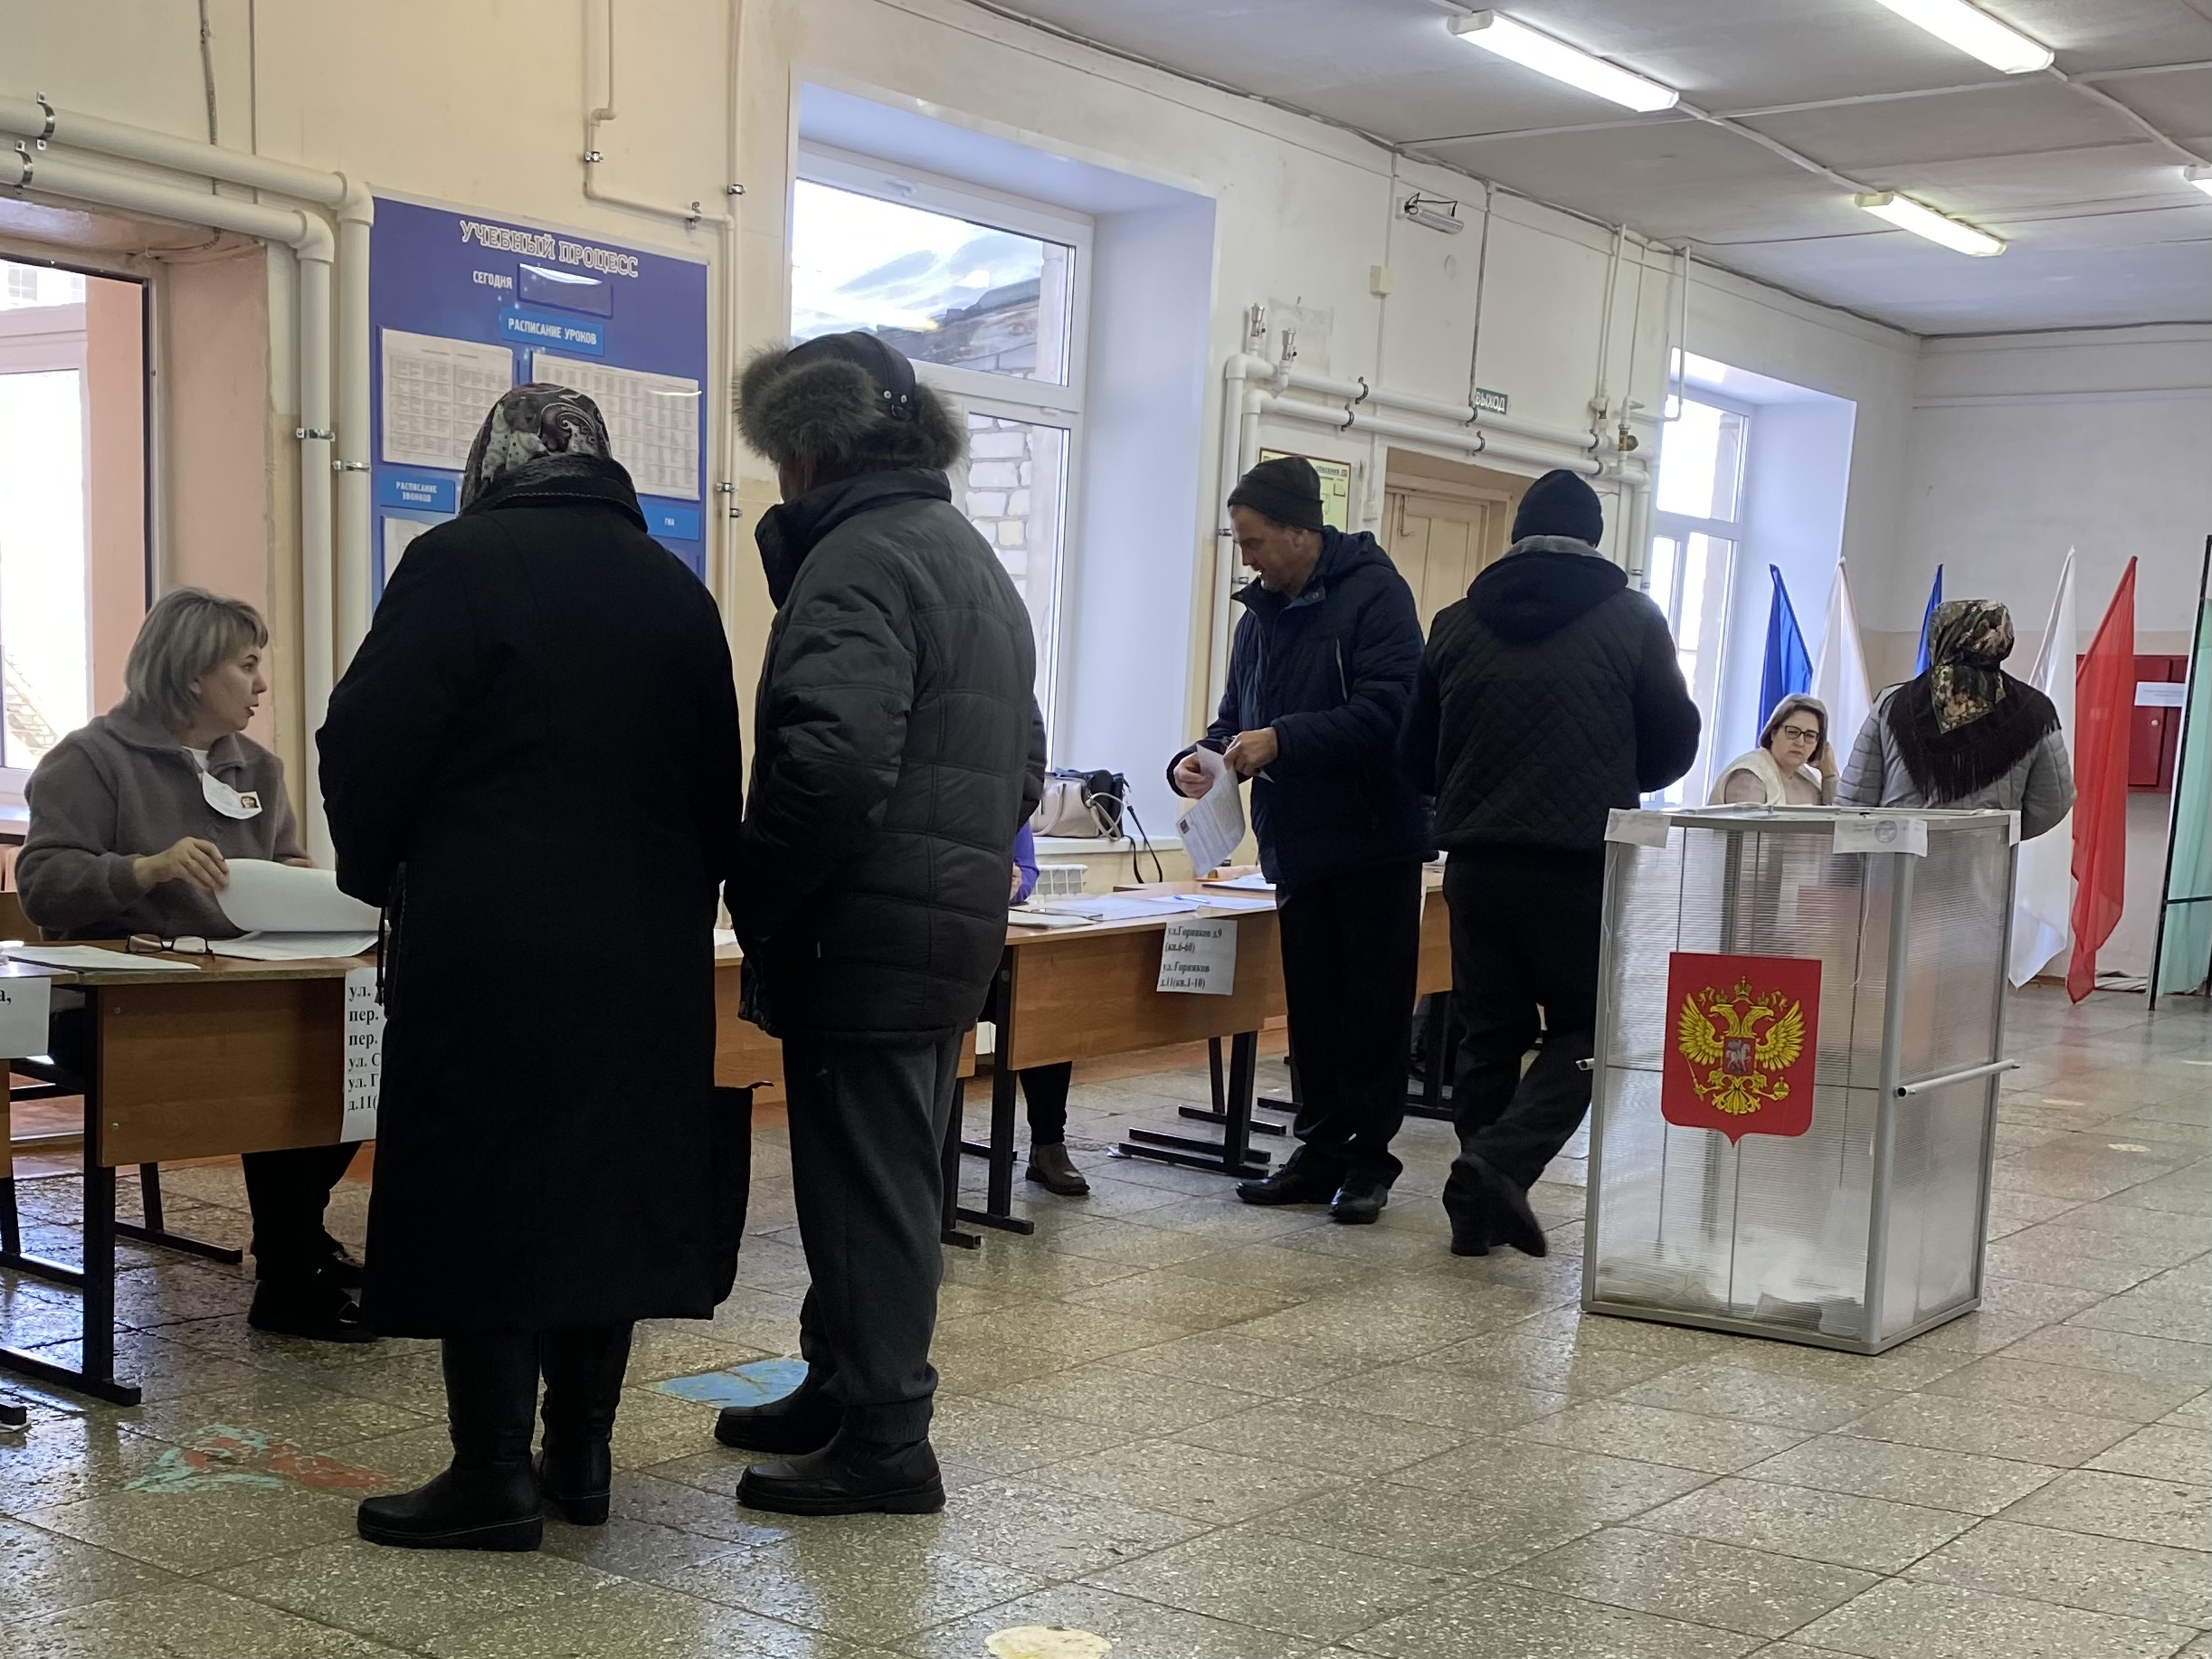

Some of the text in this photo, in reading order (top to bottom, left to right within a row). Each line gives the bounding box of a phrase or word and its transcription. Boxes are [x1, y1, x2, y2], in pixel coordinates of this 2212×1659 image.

[460, 220, 639, 278] УЧЕБНЫЙ ПРОЦЕСС
[472, 270, 513, 289] СЕГОДНЯ
[508, 318, 597, 345] РАСПИСАНИЕ УРОКОВ
[1475, 391, 1505, 412] ВЫХОД
[348, 986, 371, 1001] ул.
[349, 1010, 378, 1025] пер.
[349, 1033, 377, 1049] пер.
[348, 1057, 367, 1072] ул.
[347, 1078, 366, 1093] ул.
